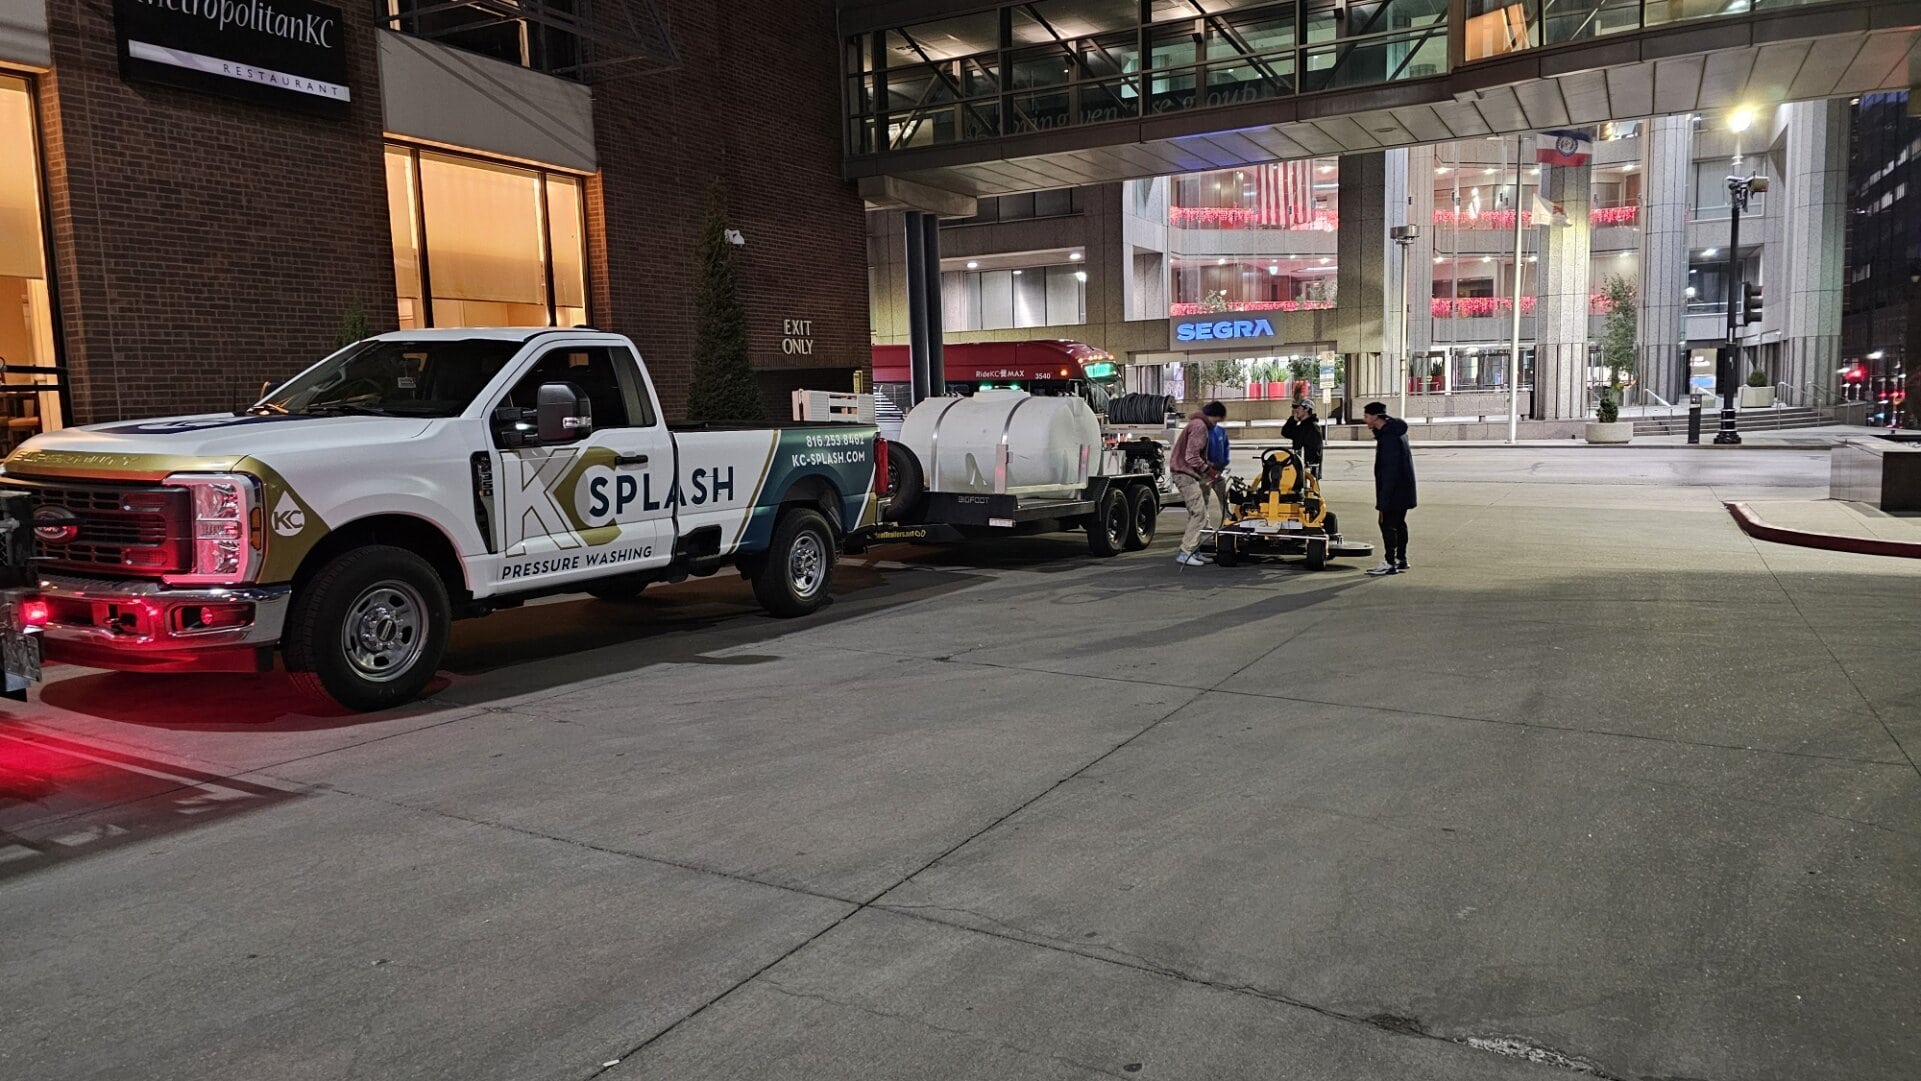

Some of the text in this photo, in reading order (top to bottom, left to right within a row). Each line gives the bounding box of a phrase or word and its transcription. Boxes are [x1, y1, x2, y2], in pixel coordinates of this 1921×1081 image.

[223, 63, 339, 96] RESTAURANT
[784, 319, 812, 335] EXIT
[1176, 319, 1274, 341] SEGRA
[782, 338, 813, 354] ONLY
[1007, 369, 1025, 377] MAX
[792, 450, 865, 467] KC-SPLASH.COM
[500, 446, 623, 558] KC
[589, 466, 734, 518] SPLASH
[958, 495, 990, 505] BIGFOOT
[273, 510, 304, 530] KC
[502, 546, 652, 580] PRESSURE WASHING
